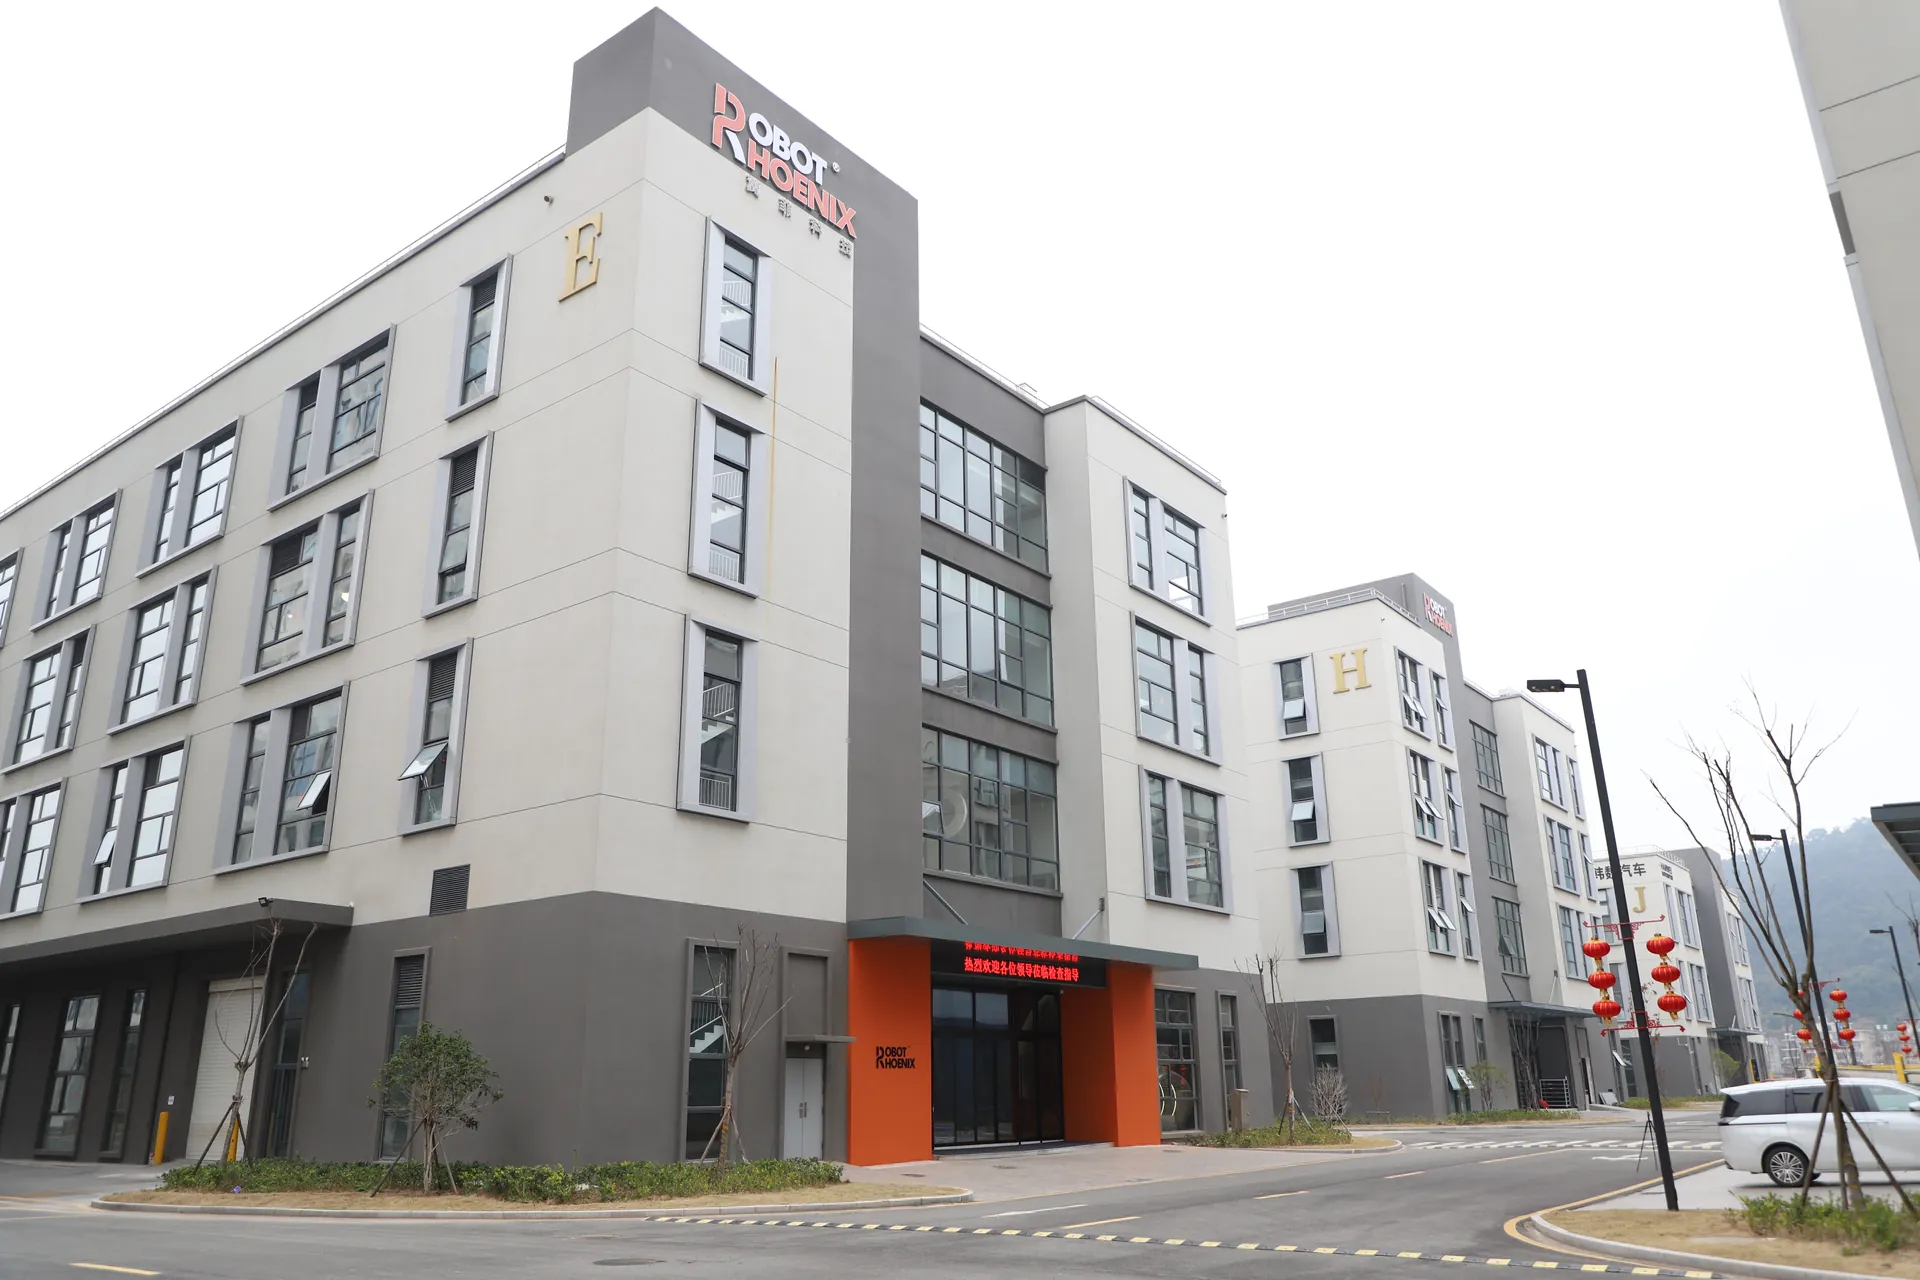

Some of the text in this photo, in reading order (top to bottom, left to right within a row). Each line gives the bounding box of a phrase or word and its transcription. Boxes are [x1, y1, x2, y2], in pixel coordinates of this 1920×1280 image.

[559, 211, 603, 303] E
[1329, 646, 1372, 695] H
[1632, 885, 1647, 914] J
[964, 956, 1079, 982] 热烈欢迎各位领导莅临检查指导
